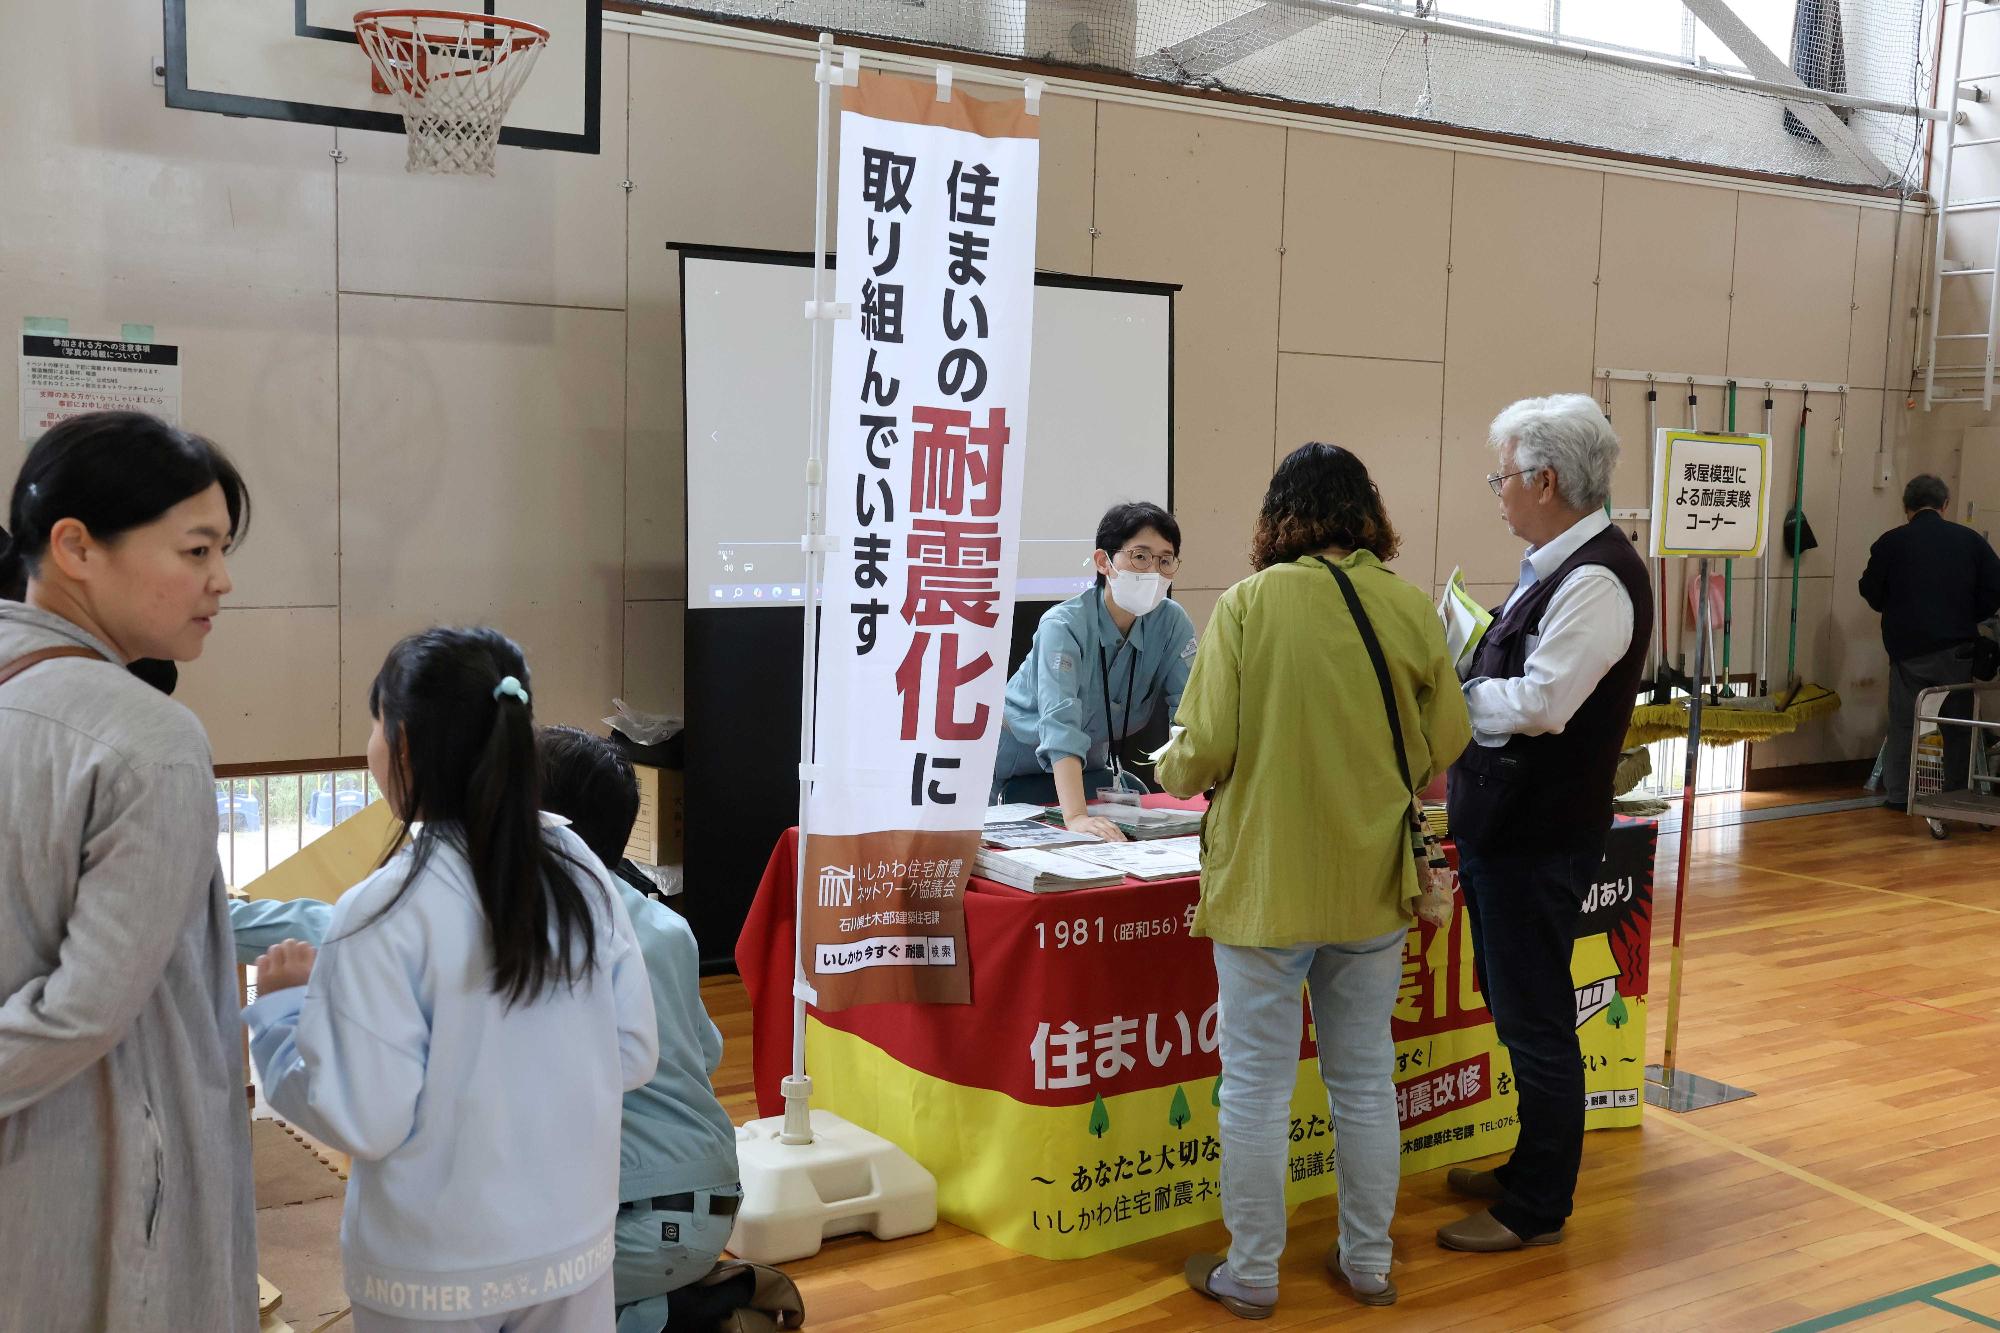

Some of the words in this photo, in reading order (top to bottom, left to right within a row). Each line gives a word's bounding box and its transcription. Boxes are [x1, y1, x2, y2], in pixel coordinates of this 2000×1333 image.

[53, 339, 150, 353] 参加される方への注意事項
[850, 146, 917, 656] 取り組んでいます
[895, 160, 1011, 806] 住まいの耐震化に
[1684, 462, 1747, 484] 家屋模型に
[1675, 486, 1752, 508] よる耐震実験
[1686, 512, 1737, 531] コーナー
[858, 858, 963, 882] いしかわ住宅耐震
[857, 879, 957, 904] ネットワーク協議会
[839, 910, 940, 933] 石川県土木部建築住宅課
[823, 945, 900, 966] いしかわ今すぐ
[905, 943, 925, 959] 耐震
[931, 944, 952, 959] 検索
[1400, 1123, 1475, 1155] 木部建築住宅課
[363, 1274, 472, 1313] ANOTHER
